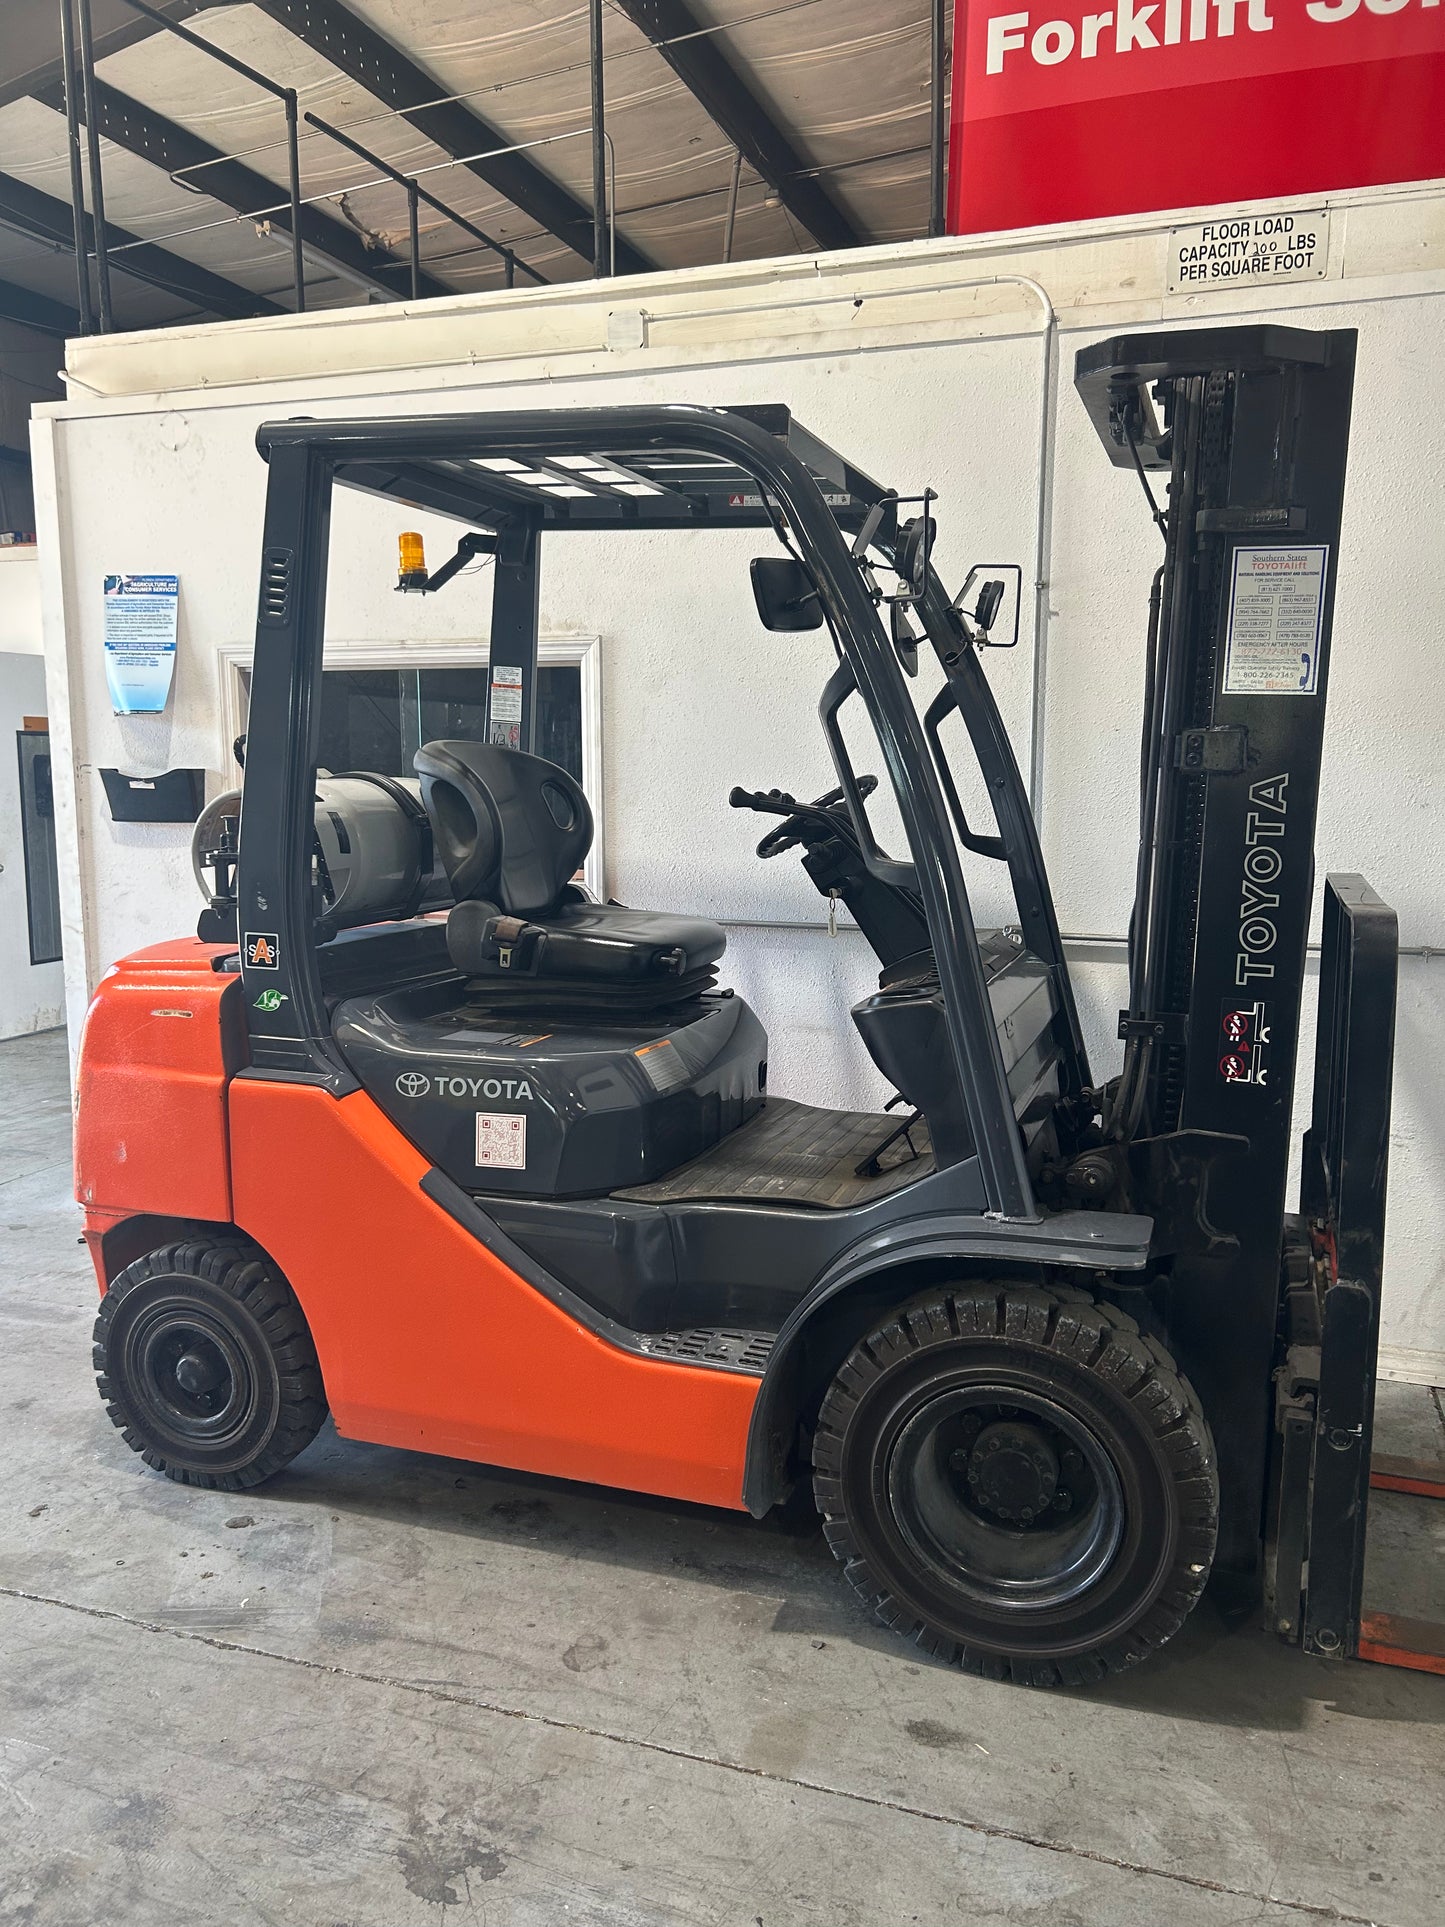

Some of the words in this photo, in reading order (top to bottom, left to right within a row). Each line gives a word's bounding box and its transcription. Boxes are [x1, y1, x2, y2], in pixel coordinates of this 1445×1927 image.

[986, 0, 1274, 75] Forklift
[1202, 221, 1250, 242] FLOOR
[1254, 217, 1294, 236] LOAD
[1179, 240, 1250, 263] CAPACITY
[1288, 233, 1316, 251] LBS
[1180, 264, 1207, 281] PER
[1211, 256, 1270, 278] SQUARE
[1274, 252, 1315, 271] FOOT
[1252, 554, 1285, 562] Southern
[1287, 553, 1308, 561] States
[1235, 772, 1289, 986] TOYOTA
[434, 1076, 534, 1100] TOYOTA
